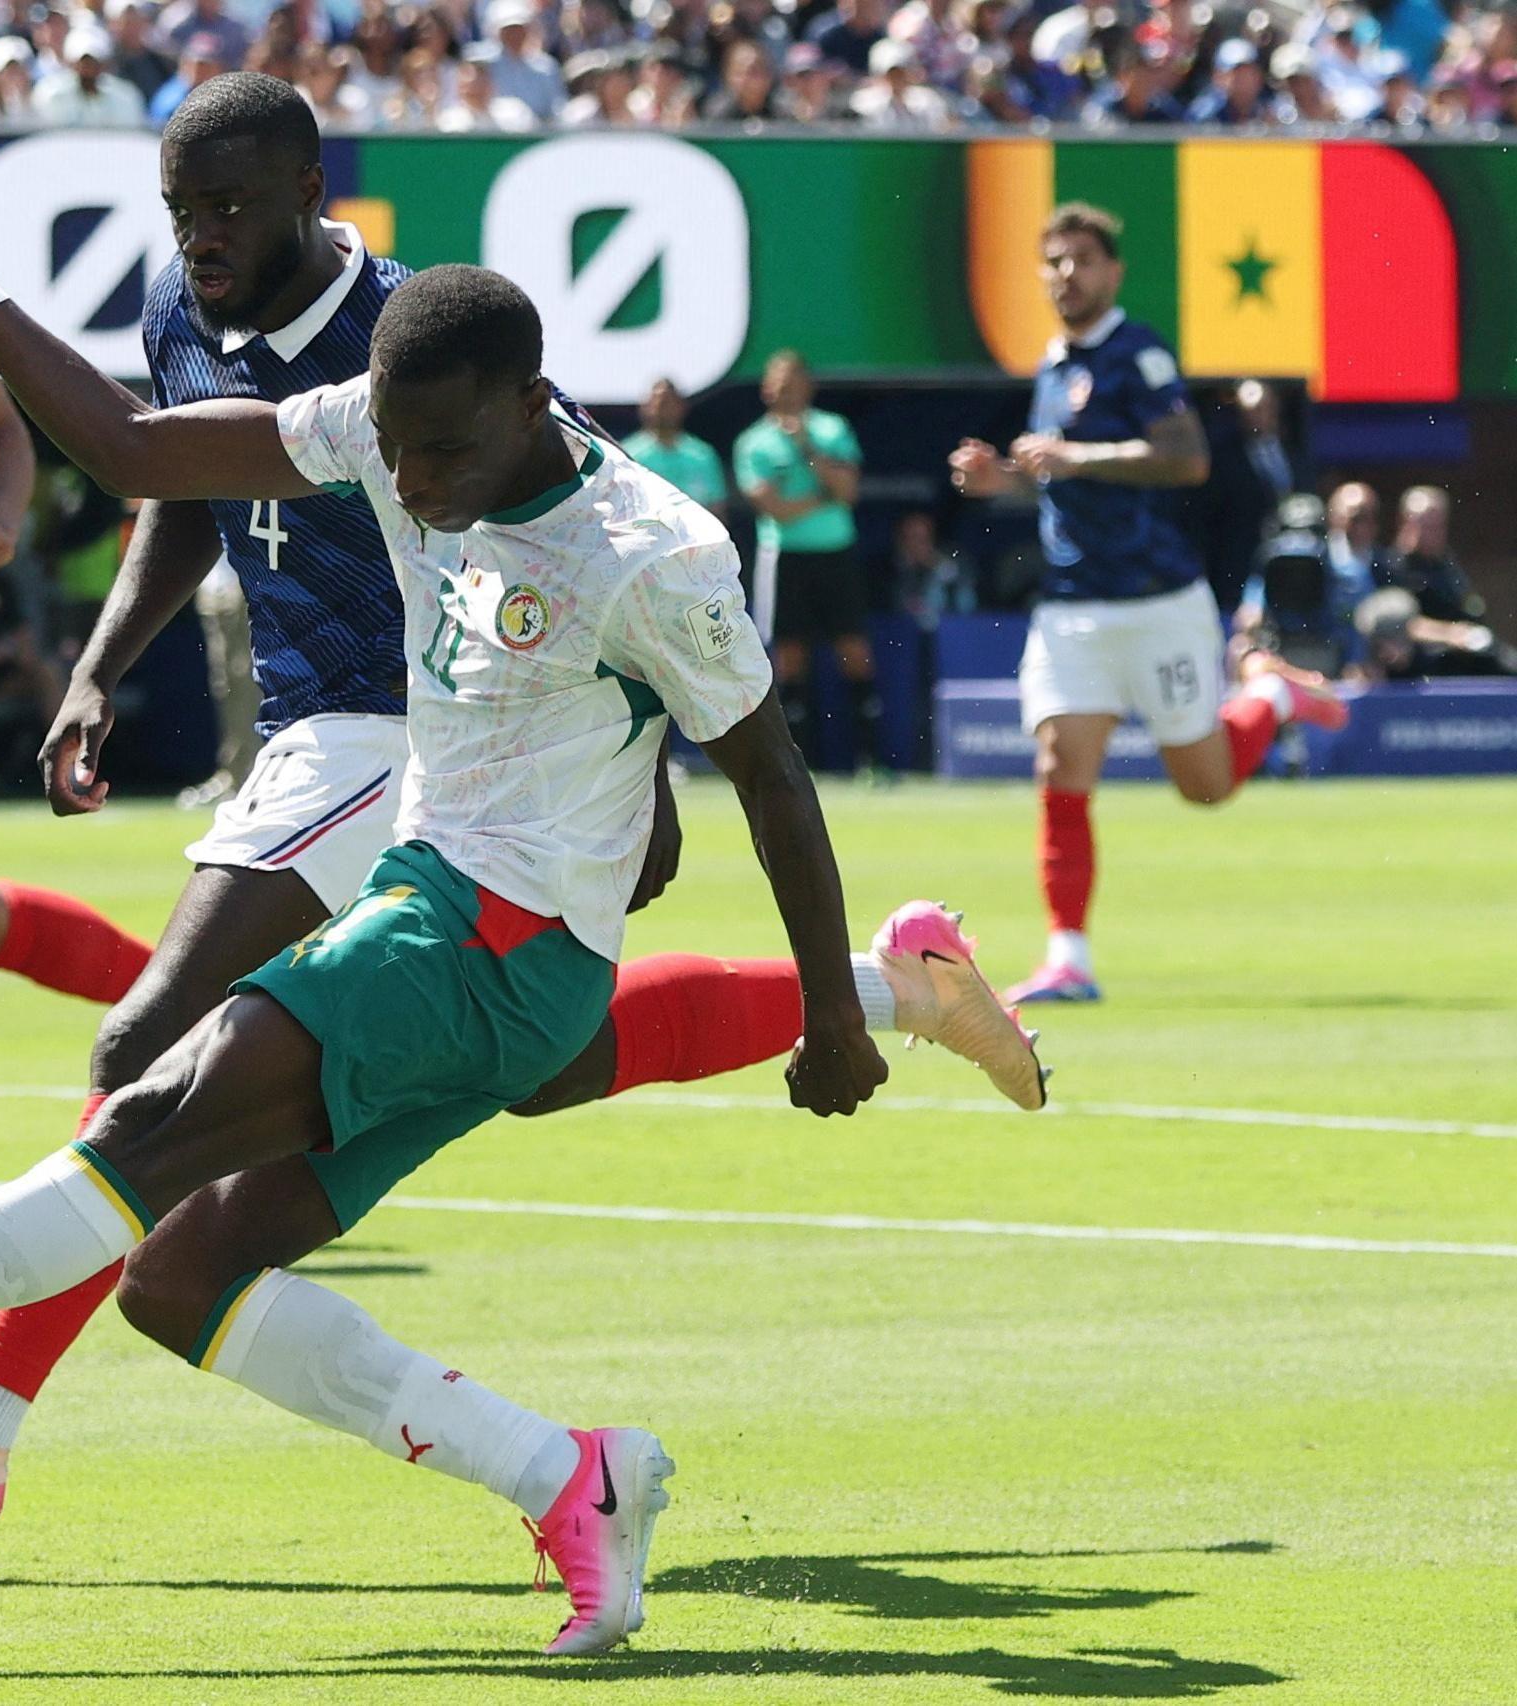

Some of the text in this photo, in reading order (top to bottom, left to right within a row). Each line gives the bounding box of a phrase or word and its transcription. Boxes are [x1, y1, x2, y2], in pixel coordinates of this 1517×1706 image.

[480, 133, 751, 404] 0
[248, 500, 288, 571] 4
[422, 577, 468, 694] 11
[1156, 659, 1201, 710] 19
